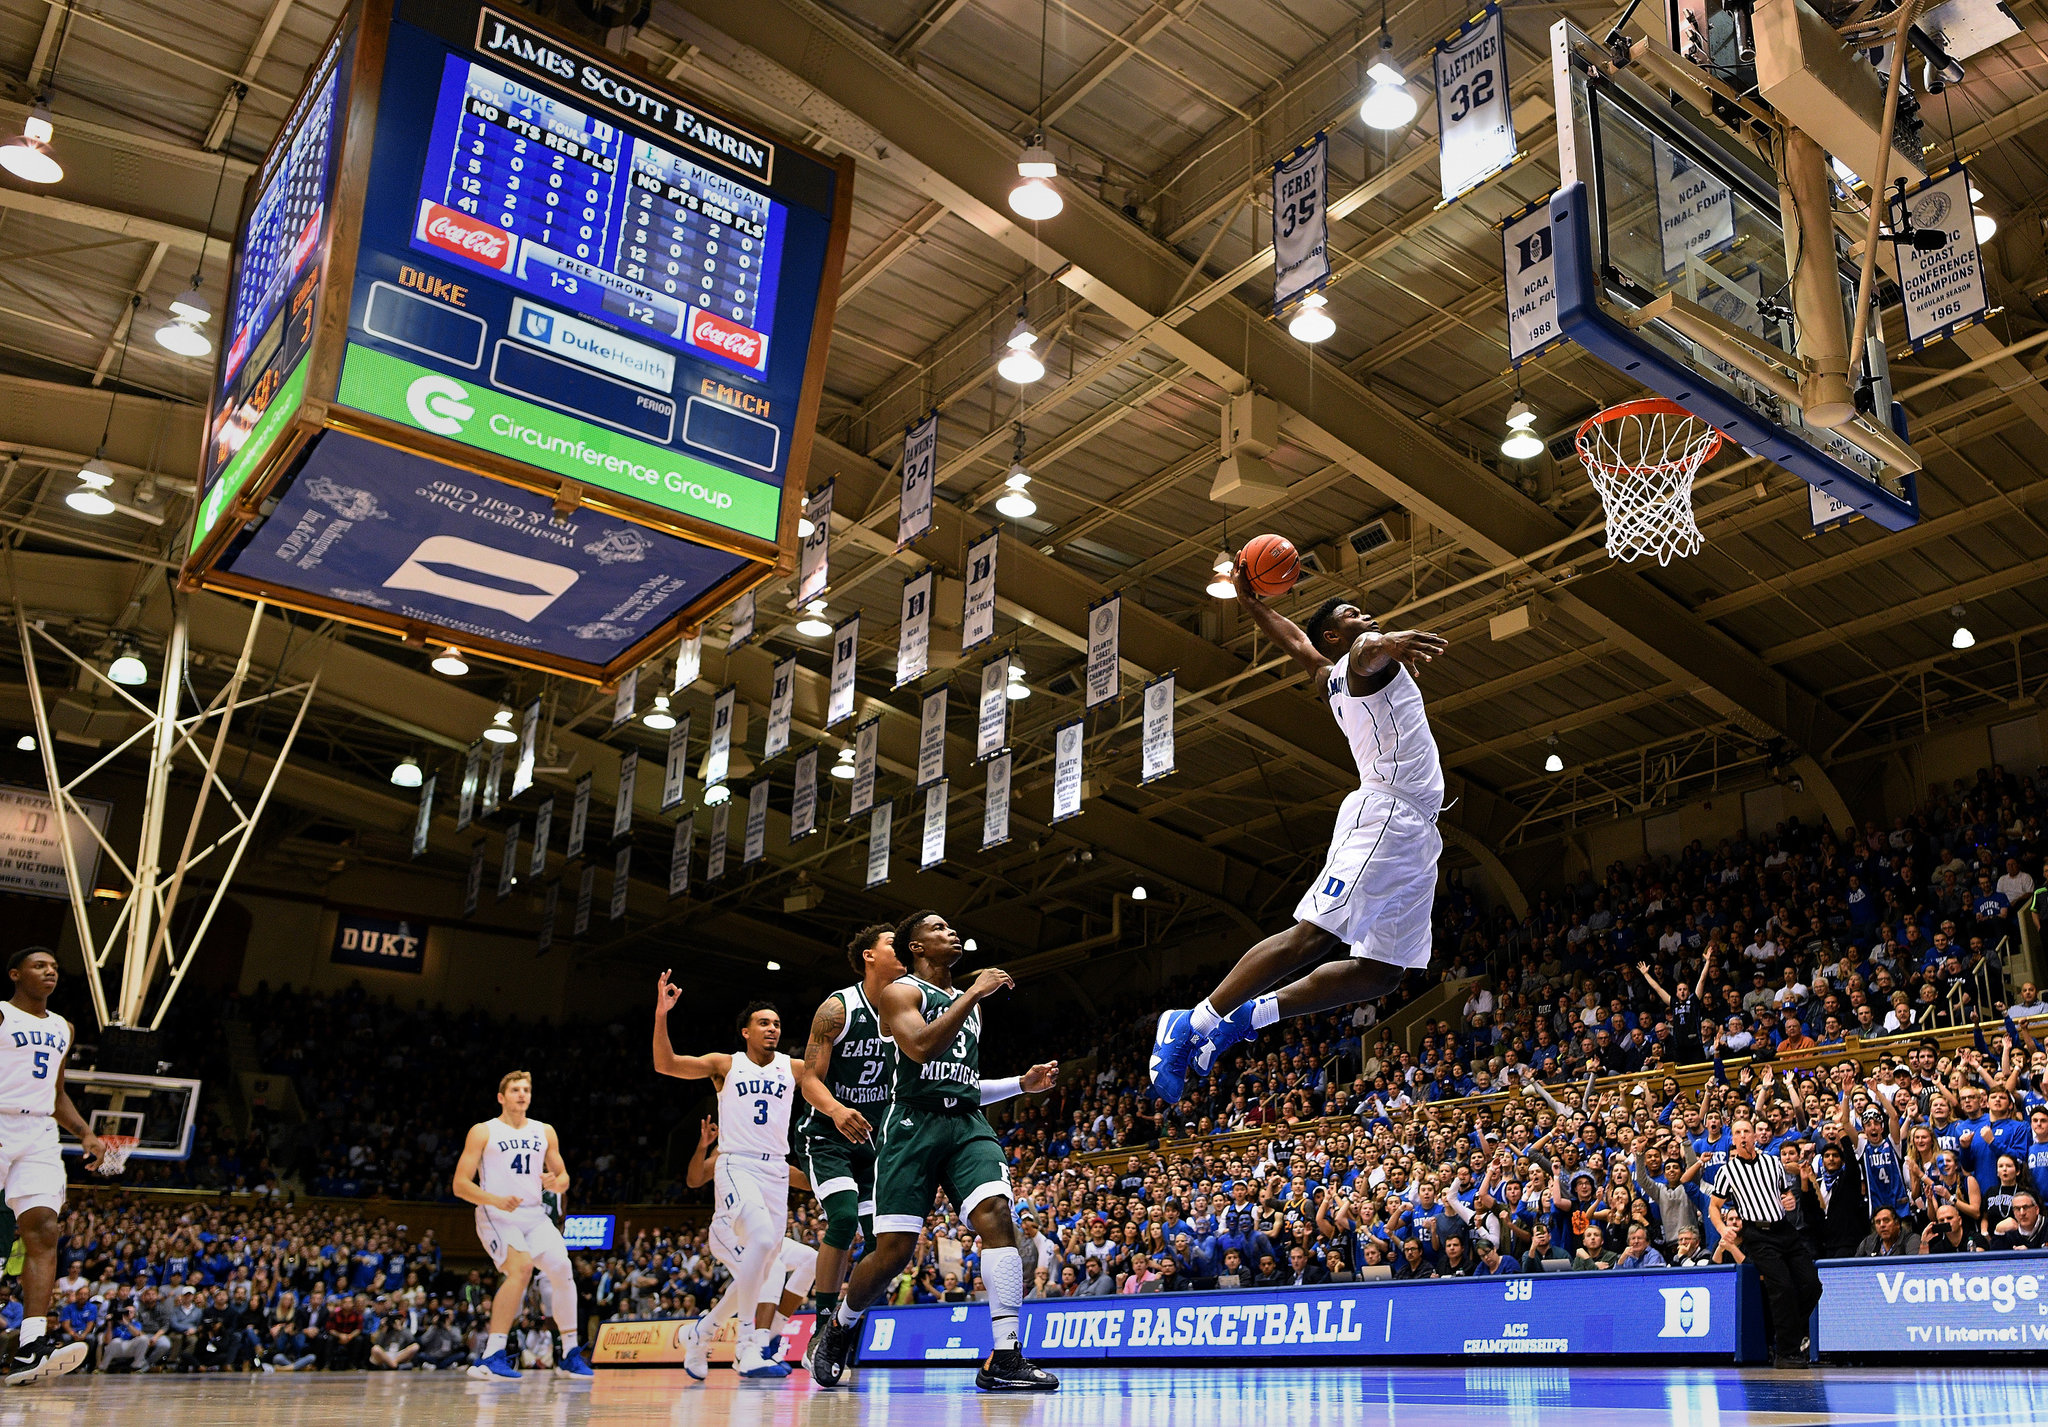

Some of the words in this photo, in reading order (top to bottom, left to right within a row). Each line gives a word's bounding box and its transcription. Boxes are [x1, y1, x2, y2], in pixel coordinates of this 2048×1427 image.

[1442, 35, 1497, 87] LAETTNER
[487, 22, 576, 79] JAMES
[581, 64, 670, 123] SCOTT
[674, 109, 764, 168] FARRIN
[503, 82, 556, 115] DUKE
[1450, 69, 1494, 122] 32
[471, 99, 499, 121] NO
[506, 115, 541, 140] PTS
[545, 132, 579, 157] REB
[582, 148, 614, 173] FLS
[519, 108, 533, 120] 4
[546, 118, 589, 145] FOULS
[471, 140, 485, 155] 3
[510, 157, 524, 172] 0
[549, 173, 562, 188] 0
[585, 189, 599, 204] 0
[478, 122, 486, 136] 1
[514, 138, 527, 154] 2
[552, 155, 565, 170] 2
[591, 172, 599, 186] 1
[468, 158, 481, 174] 5
[507, 175, 520, 190] 3
[546, 191, 559, 206] 0
[582, 207, 596, 222] 0
[691, 166, 764, 209] MICHIGAN
[702, 189, 740, 213] FOULS
[1281, 163, 1319, 203] FERRY
[1678, 180, 1707, 204] NCAA
[461, 176, 482, 195] 12
[503, 193, 517, 209] 2
[545, 210, 553, 225] 1
[579, 225, 593, 240] 0
[637, 172, 661, 194] NO
[668, 186, 699, 210] PTS
[702, 201, 733, 224] REB
[735, 216, 764, 239] FLS
[640, 193, 653, 209] 2
[674, 209, 687, 223] 0
[708, 223, 720, 238] 2
[741, 238, 753, 252] 0
[1282, 189, 1317, 238] 35
[1664, 209, 1694, 232] FINAL
[1696, 188, 1726, 214] FOUR
[457, 195, 479, 214] 41
[500, 212, 514, 228] 0
[542, 229, 551, 243] 1
[576, 243, 590, 258] 0
[637, 211, 650, 226] 3
[672, 226, 684, 241] 2
[706, 240, 718, 255] 0
[738, 254, 751, 269] 0
[1684, 229, 1711, 250] 1989
[630, 245, 648, 263] 12
[667, 261, 679, 275] 0
[701, 275, 714, 290] 0
[734, 289, 746, 303] 0
[635, 229, 648, 244] 5
[669, 243, 682, 258] 0
[703, 258, 716, 272] 0
[738, 272, 746, 286] 1
[1905, 250, 1975, 292] CONFERENCE
[1919, 246, 1955, 270] COAST
[398, 265, 468, 307] DUKE
[557, 256, 592, 277] FREE
[599, 276, 653, 302] THROWS
[626, 263, 645, 281] 21
[664, 279, 677, 293] 0
[699, 293, 711, 307] 0
[732, 306, 744, 321] 0
[1523, 275, 1549, 297] NCAA
[1909, 265, 1974, 302] CHAMPIONS
[1916, 293, 1945, 313] REGULAR
[1945, 282, 1971, 299] SEASON
[550, 271, 578, 294] 1-3
[627, 301, 655, 325] 1-2
[1511, 300, 1537, 322] FINAL
[1539, 288, 1556, 307] FOU
[1930, 300, 1961, 321] 1965
[1528, 320, 1551, 341] 1988
[561, 328, 666, 380] DukeHealth
[636, 395, 672, 416] PERIOD
[700, 377, 771, 418] EMICH
[489, 414, 661, 486] Circumference
[663, 470, 733, 510] Group
[905, 454, 930, 492] 24
[415, 487, 467, 513] Duke
[433, 480, 479, 503] Club
[480, 497, 525, 519] Golf
[472, 507, 574, 548] Washington
[1321, 875, 1346, 898] D
[341, 926, 419, 959] DUKE
[11, 1031, 66, 1054] DUKE
[952, 1030, 966, 1058] 3
[32, 1051, 49, 1079] 5
[858, 1060, 884, 1085] 21
[735, 1079, 787, 1098] DUKE
[754, 1099, 768, 1125] 3
[497, 1137, 543, 1153] DUKE
[510, 1153, 531, 1175] 41
[1879, 1168, 1890, 1183] 4
[1504, 1279, 1532, 1301] 39
[1876, 1271, 2040, 1313] Vantage
[1041, 1309, 1126, 1348] DUKE
[1128, 1299, 1363, 1346] BASKETBALL
[1502, 1323, 1528, 1337] ACC
[1906, 1326, 1932, 1342] TV
[1944, 1325, 2018, 1342] Internet
[1463, 1338, 1568, 1353] CHAMPIONSHIPS
